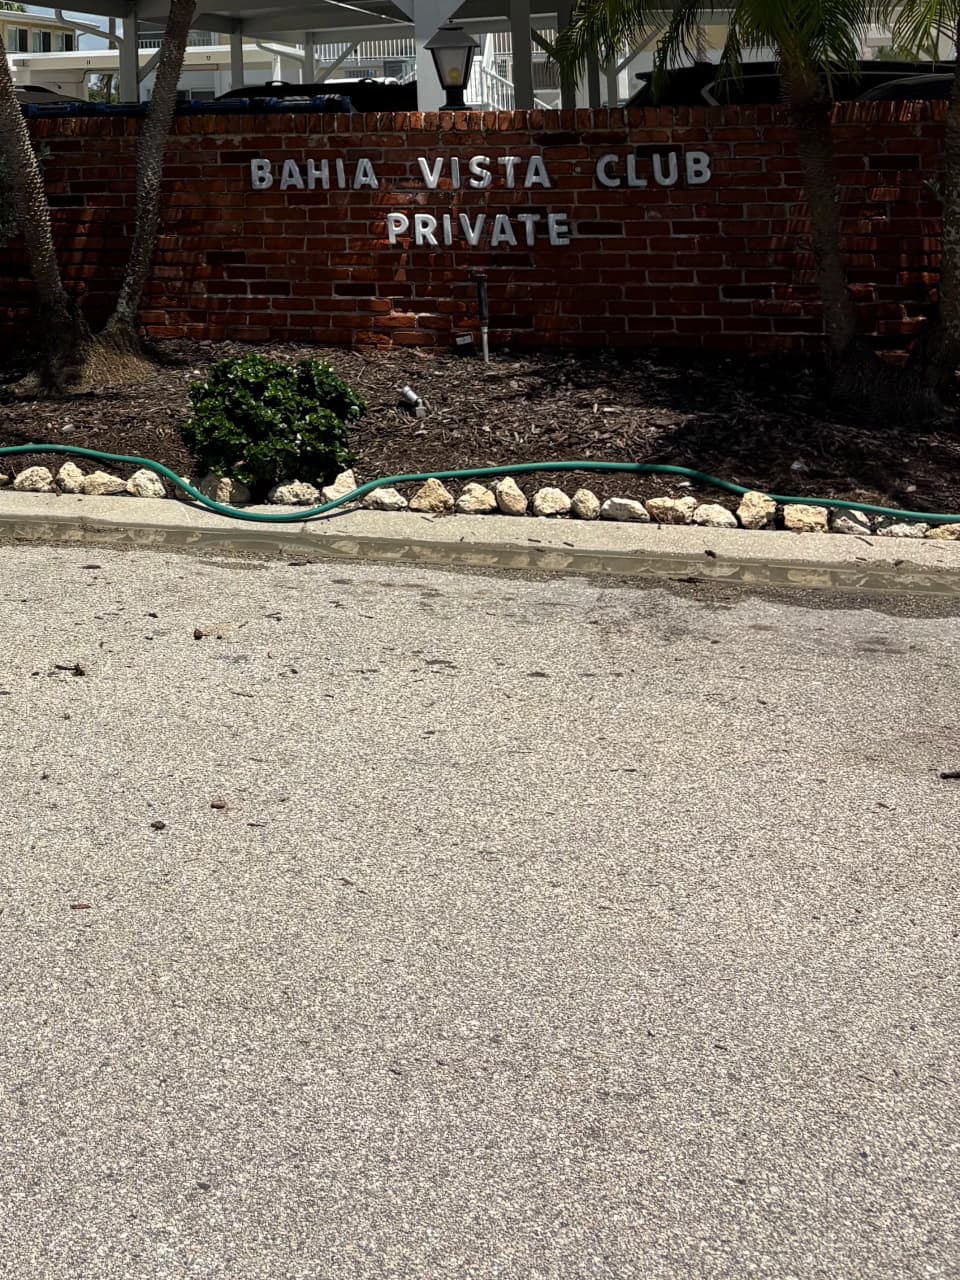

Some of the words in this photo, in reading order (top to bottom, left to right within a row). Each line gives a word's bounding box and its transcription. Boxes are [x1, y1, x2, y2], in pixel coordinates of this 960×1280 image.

[249, 156, 379, 191] BAHIA
[417, 154, 552, 189] VISTA
[595, 150, 713, 187] CLUB
[386, 211, 571, 247] PRIVATE
